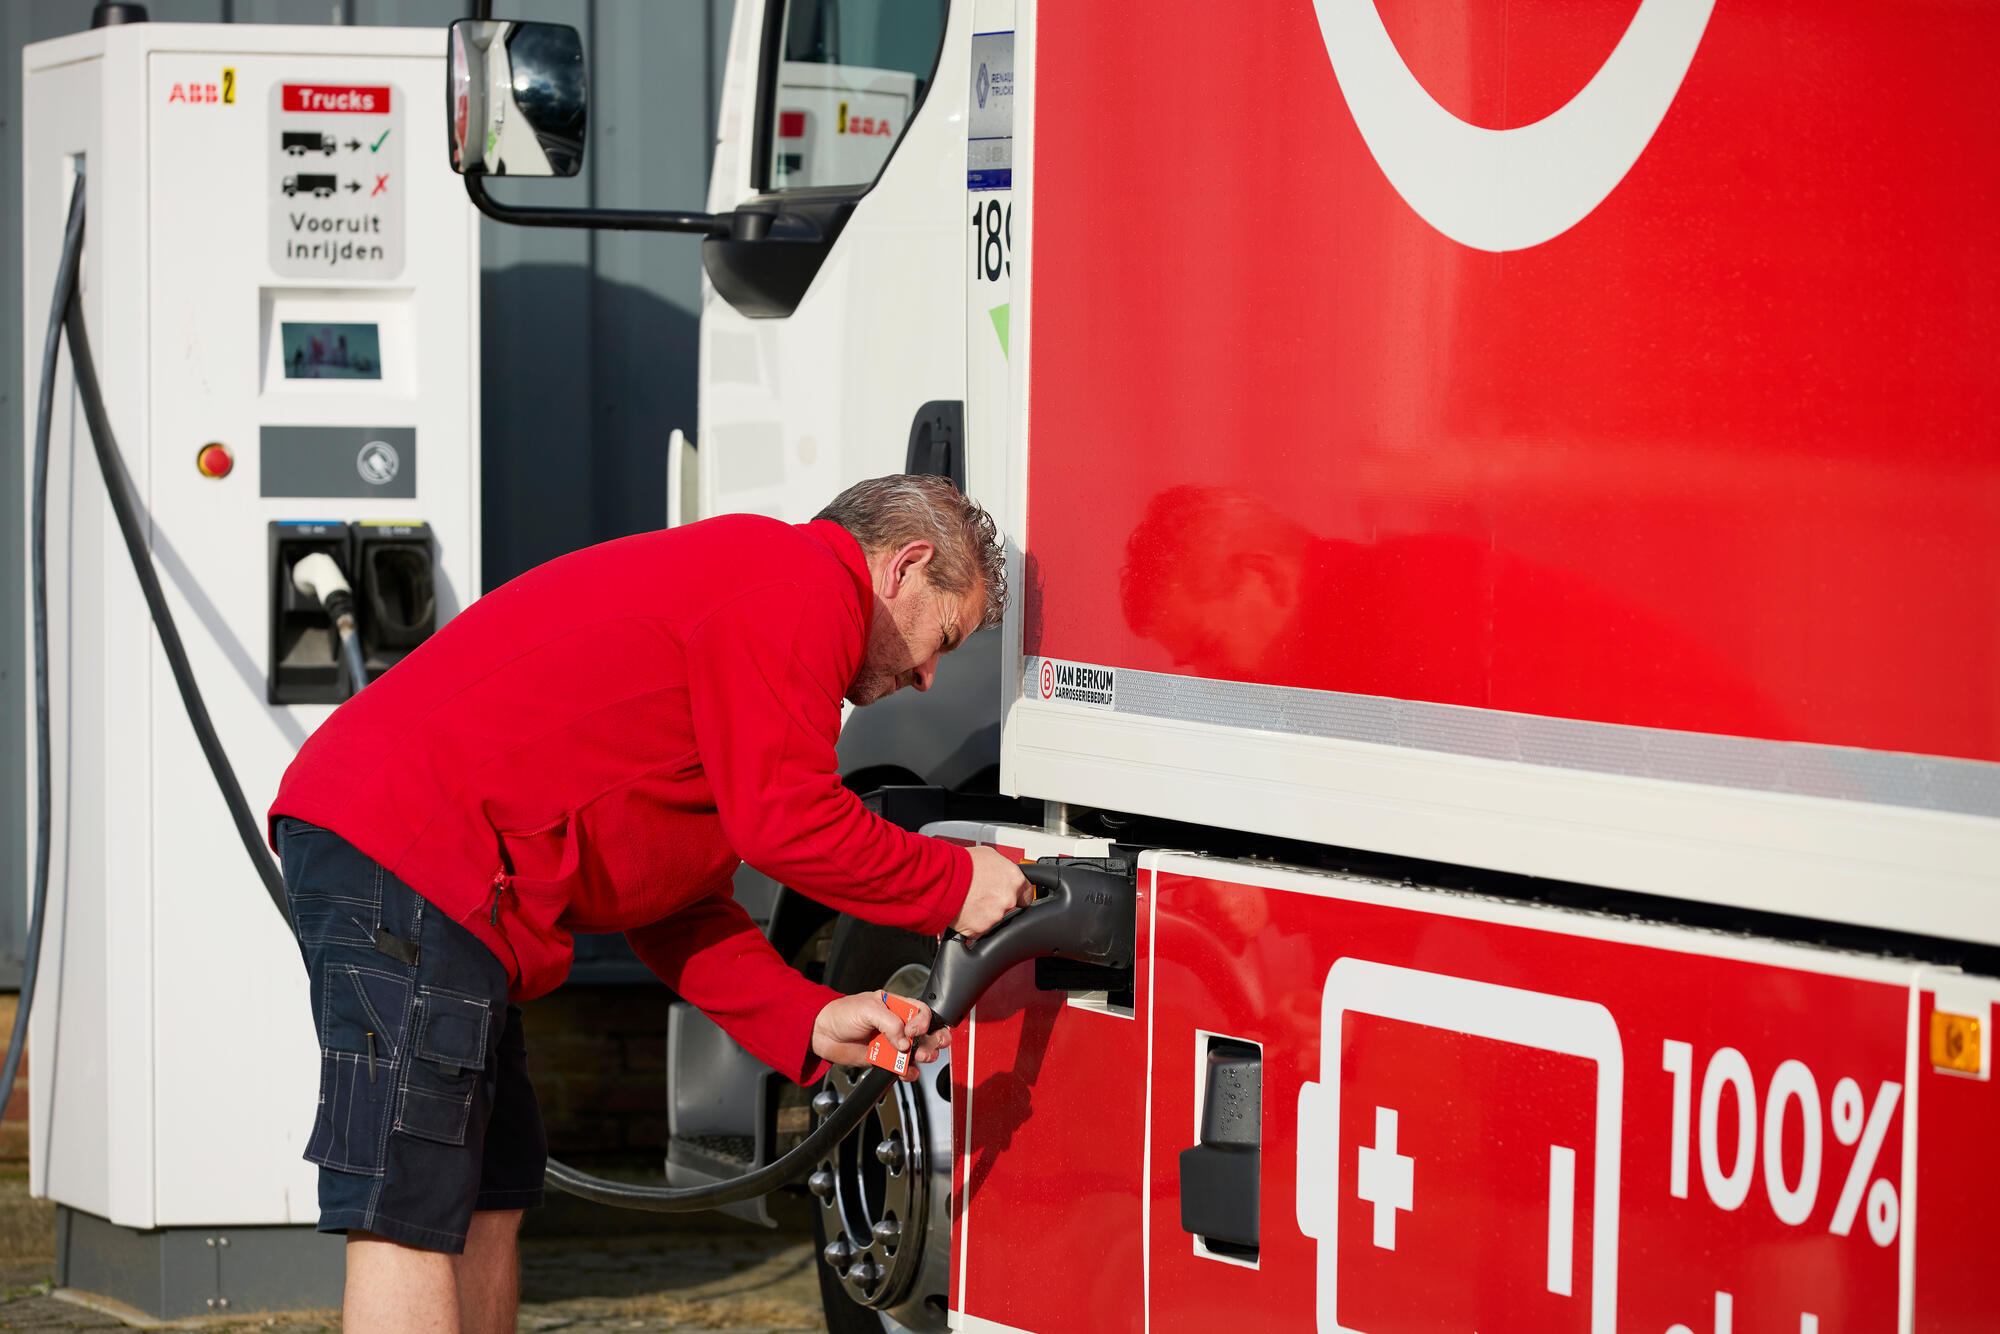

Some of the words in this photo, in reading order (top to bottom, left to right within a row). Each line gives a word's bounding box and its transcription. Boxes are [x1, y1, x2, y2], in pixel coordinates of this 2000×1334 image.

[169, 83, 218, 104] ABB
[223, 71, 234, 104] 2
[298, 88, 375, 111] Trucks
[290, 213, 381, 233] Vooruit
[286, 240, 384, 266] inrijden
[1056, 665, 1074, 686] VAN
[1076, 668, 1114, 692] BERKUM
[1055, 686, 1113, 705] CARROSSERIEBEDRIJF
[896, 1056, 905, 1071] 189
[1662, 1038, 1904, 1248] 100%
